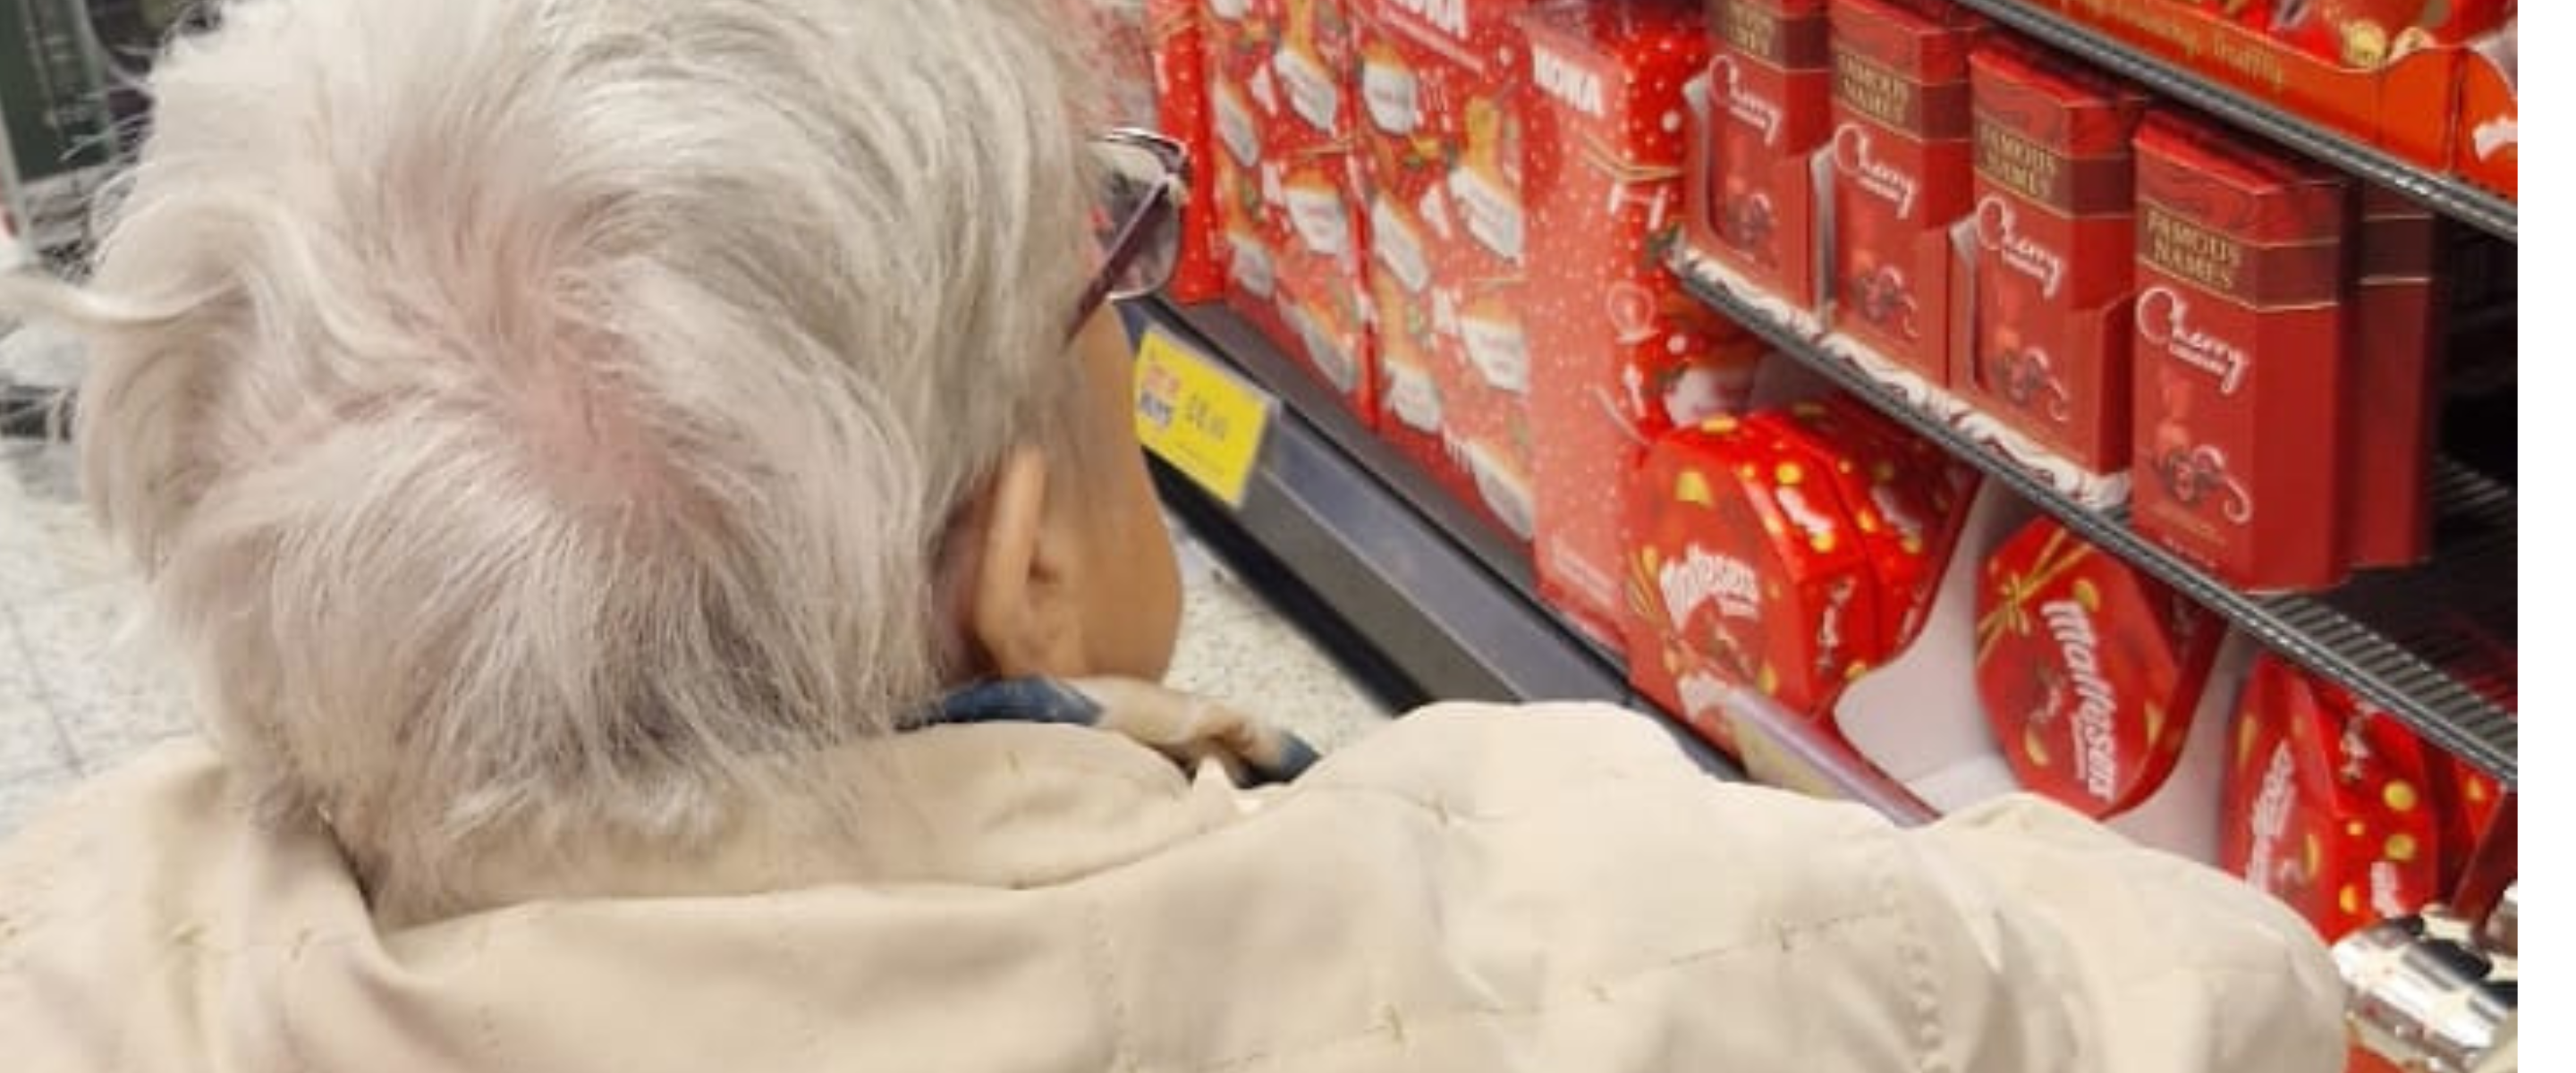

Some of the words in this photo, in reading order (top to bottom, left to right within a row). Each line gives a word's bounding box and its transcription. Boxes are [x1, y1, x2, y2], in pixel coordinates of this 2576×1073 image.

[1834, 122, 1917, 218] Cherry
[1978, 197, 2066, 299] Cherry
[2148, 209, 2241, 266] FAMOUS
[2154, 232, 2233, 291] NAMES
[2136, 287, 2250, 394] Cherry
